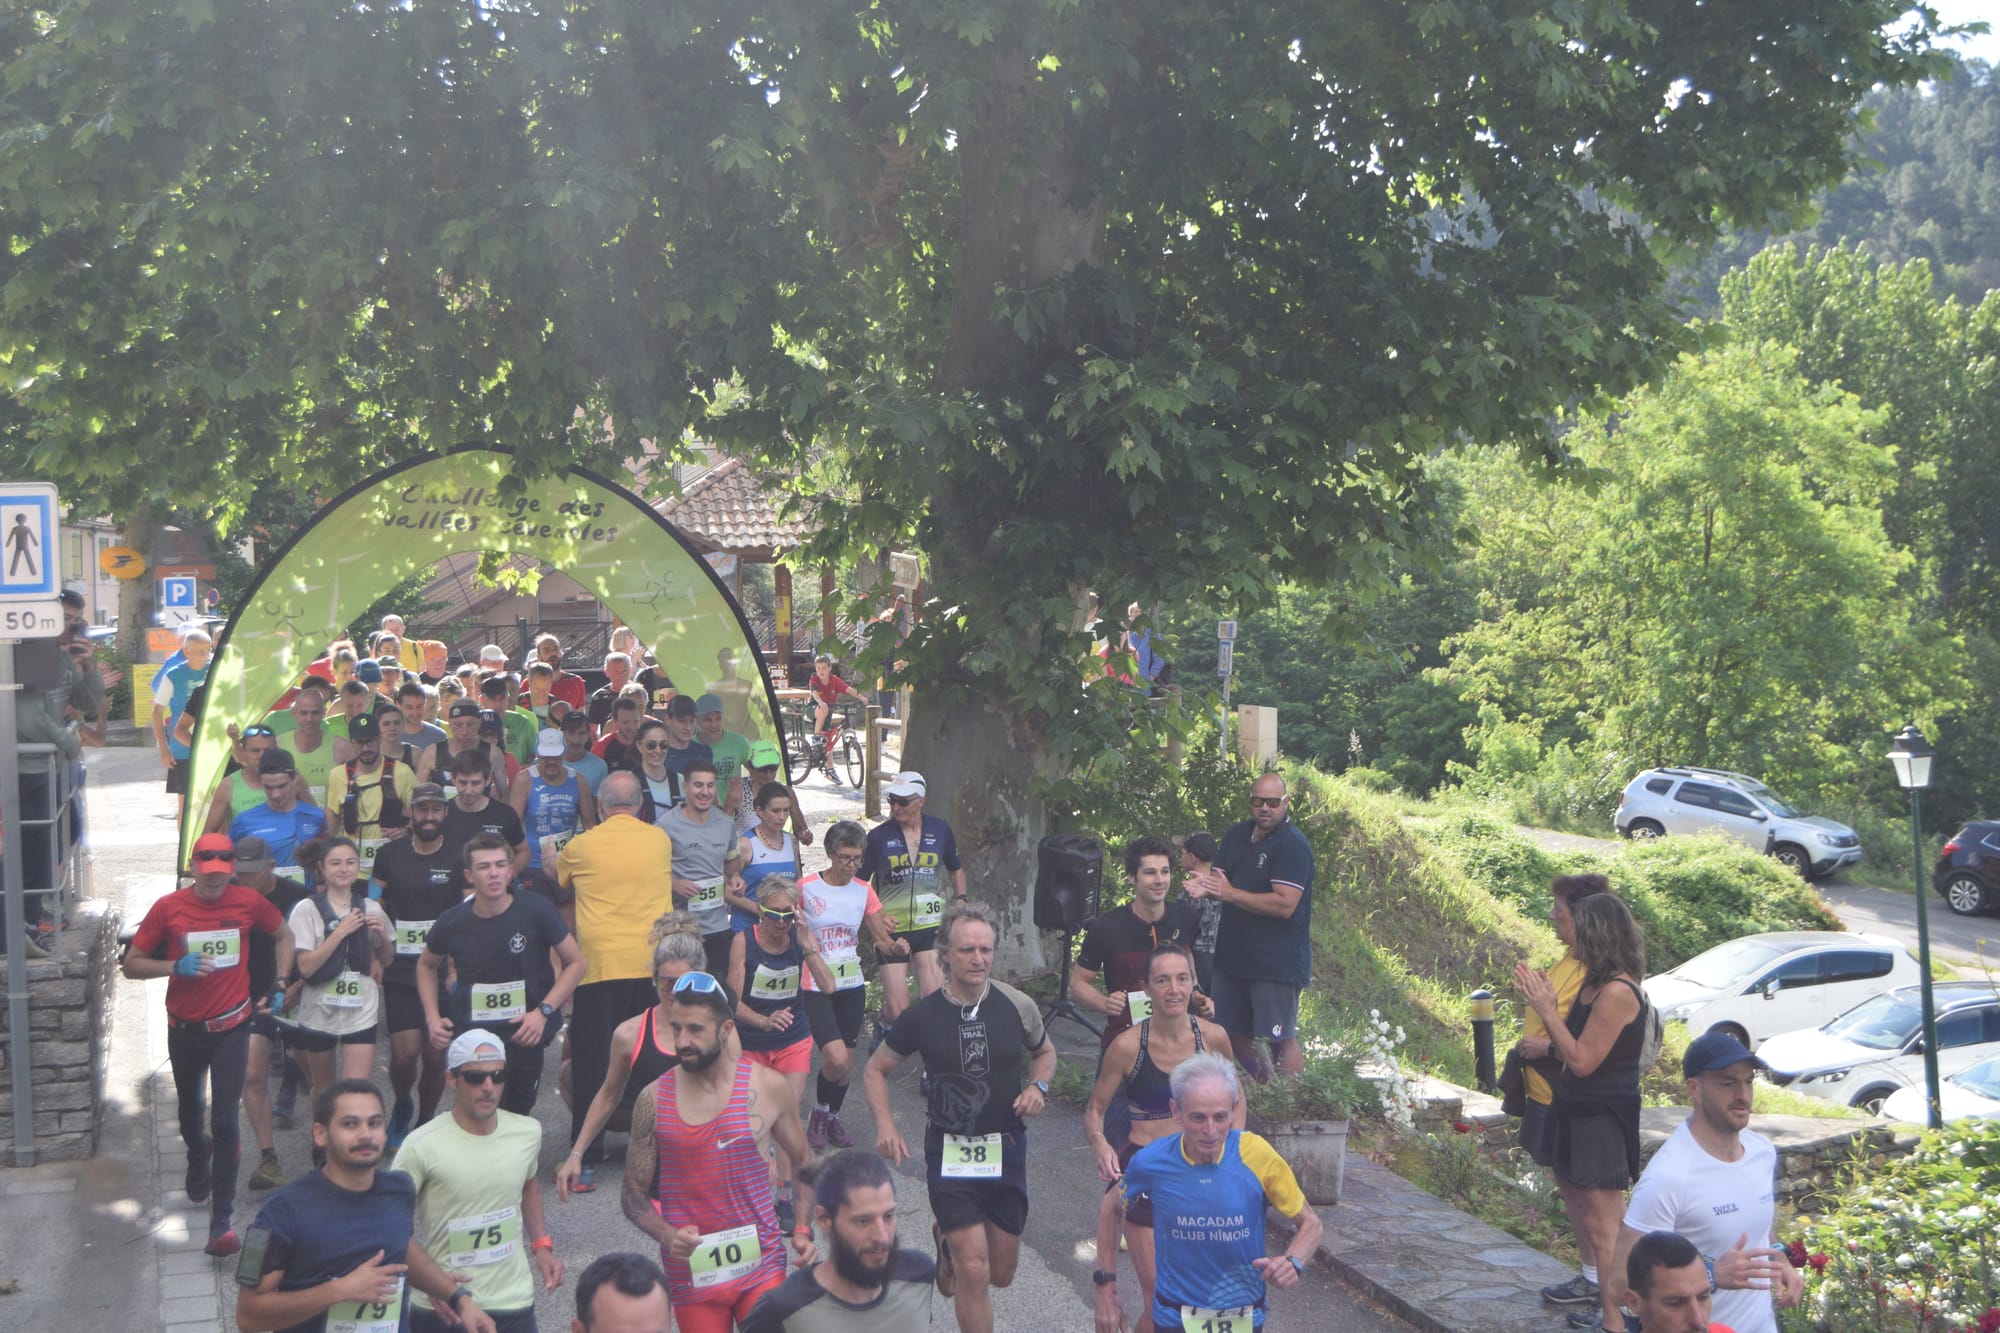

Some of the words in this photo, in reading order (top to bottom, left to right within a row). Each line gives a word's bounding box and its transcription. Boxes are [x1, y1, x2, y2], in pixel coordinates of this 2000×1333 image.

[402, 484, 541, 517] Callege
[172, 583, 187, 603] P
[5, 611, 36, 631] 50
[40, 618, 56, 630] m
[699, 886, 717, 901] 55
[926, 901, 941, 915] 36
[407, 930, 425, 944] 51
[202, 940, 228, 956] 69
[837, 964, 845, 977] 1
[335, 981, 359, 996] 86
[765, 977, 788, 991] 41
[486, 992, 512, 1009] 88
[959, 1146, 987, 1164] 38
[1177, 1214, 1244, 1228] MACADAM
[469, 1225, 503, 1249] 75
[1171, 1229, 1206, 1241] CLUB
[1209, 1227, 1250, 1243] NÎMOIS
[708, 1243, 742, 1267] 10
